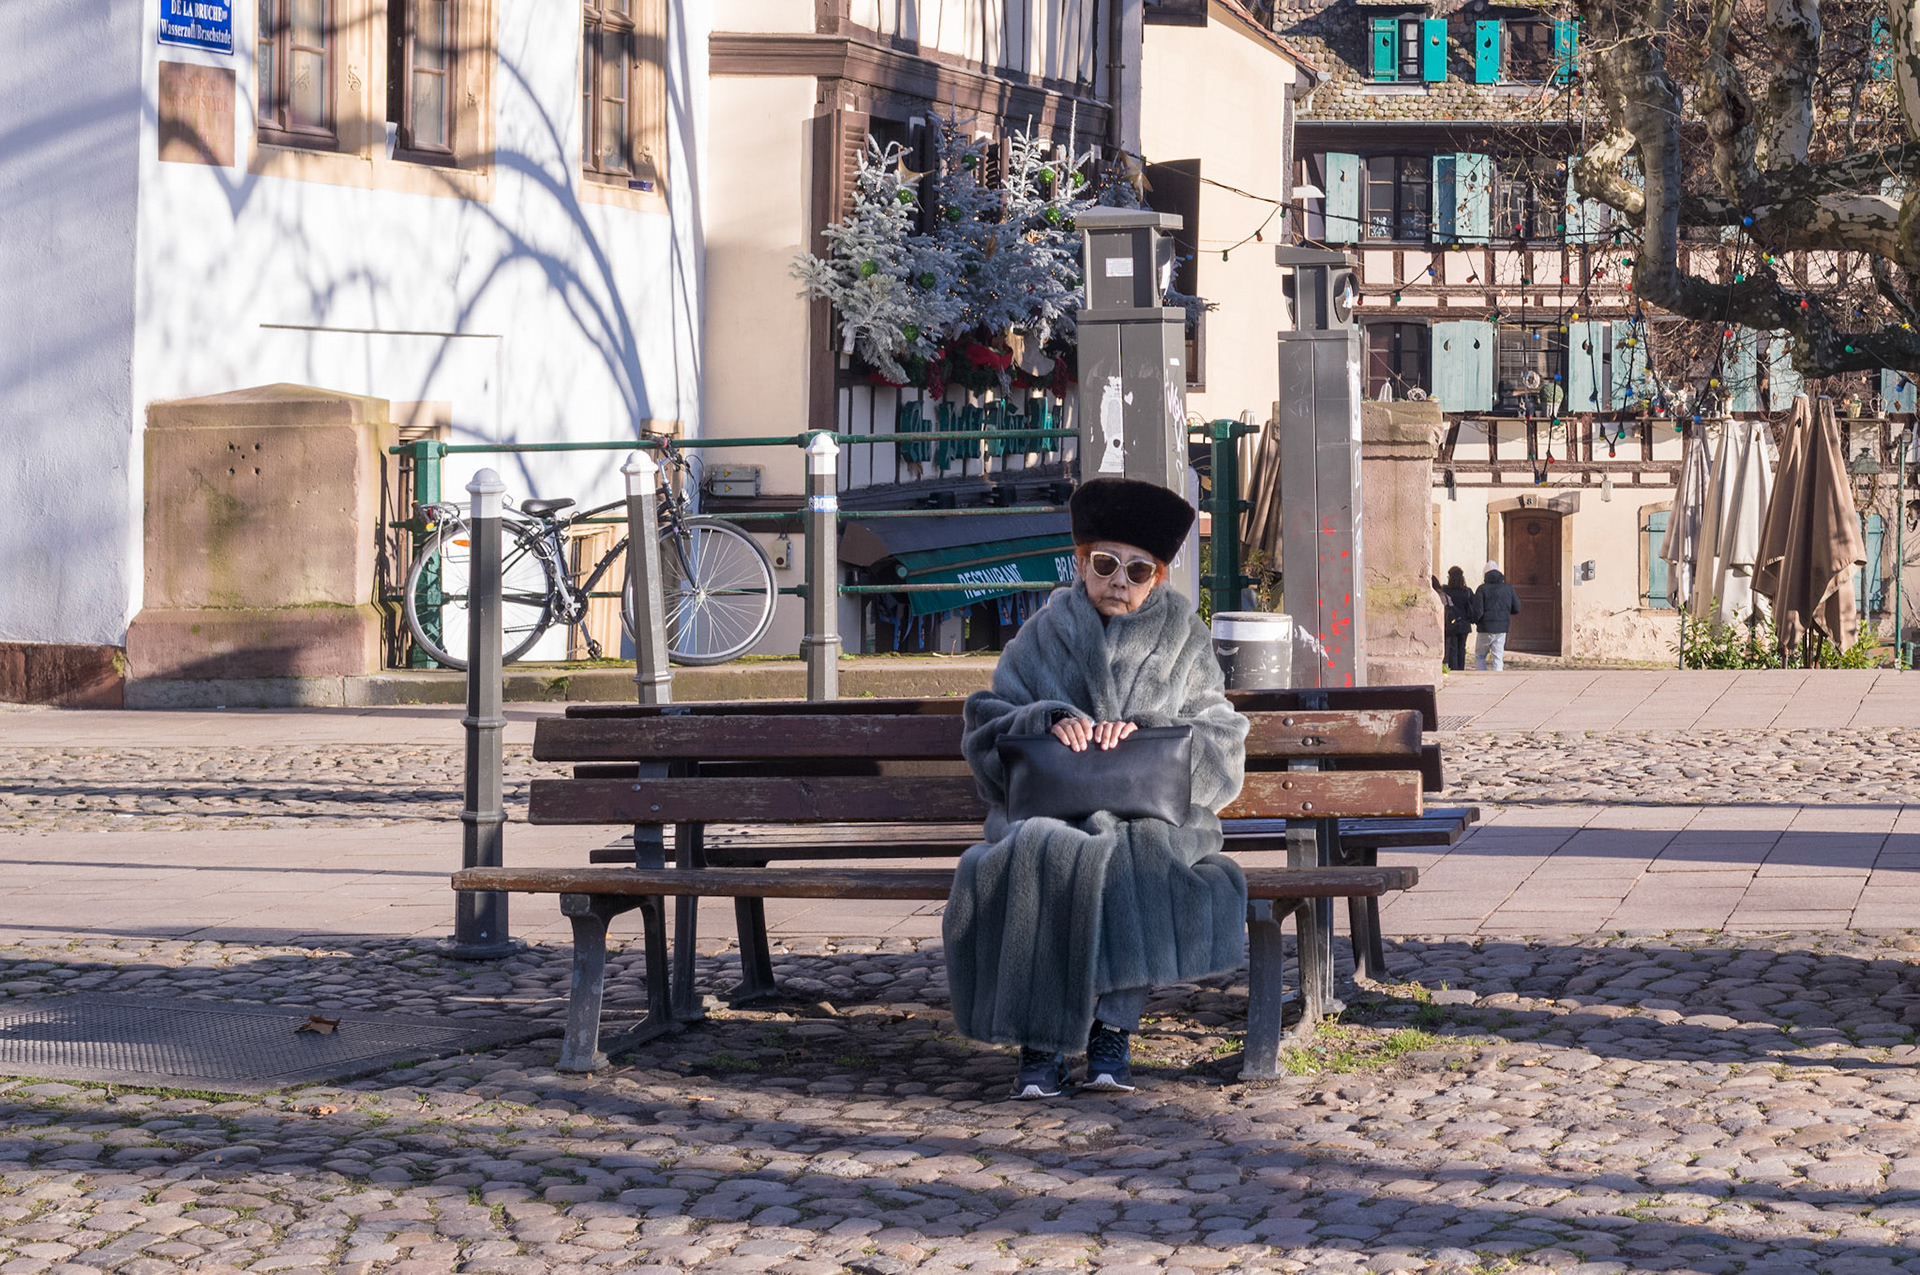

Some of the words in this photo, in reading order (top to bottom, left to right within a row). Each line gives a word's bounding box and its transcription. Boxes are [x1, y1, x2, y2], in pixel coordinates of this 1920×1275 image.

[171, 0, 181, 15] DE
[183, 0, 193, 17] LA
[194, 2, 223, 22] BRUCHE
[957, 563, 1024, 599] RESTAURANT
